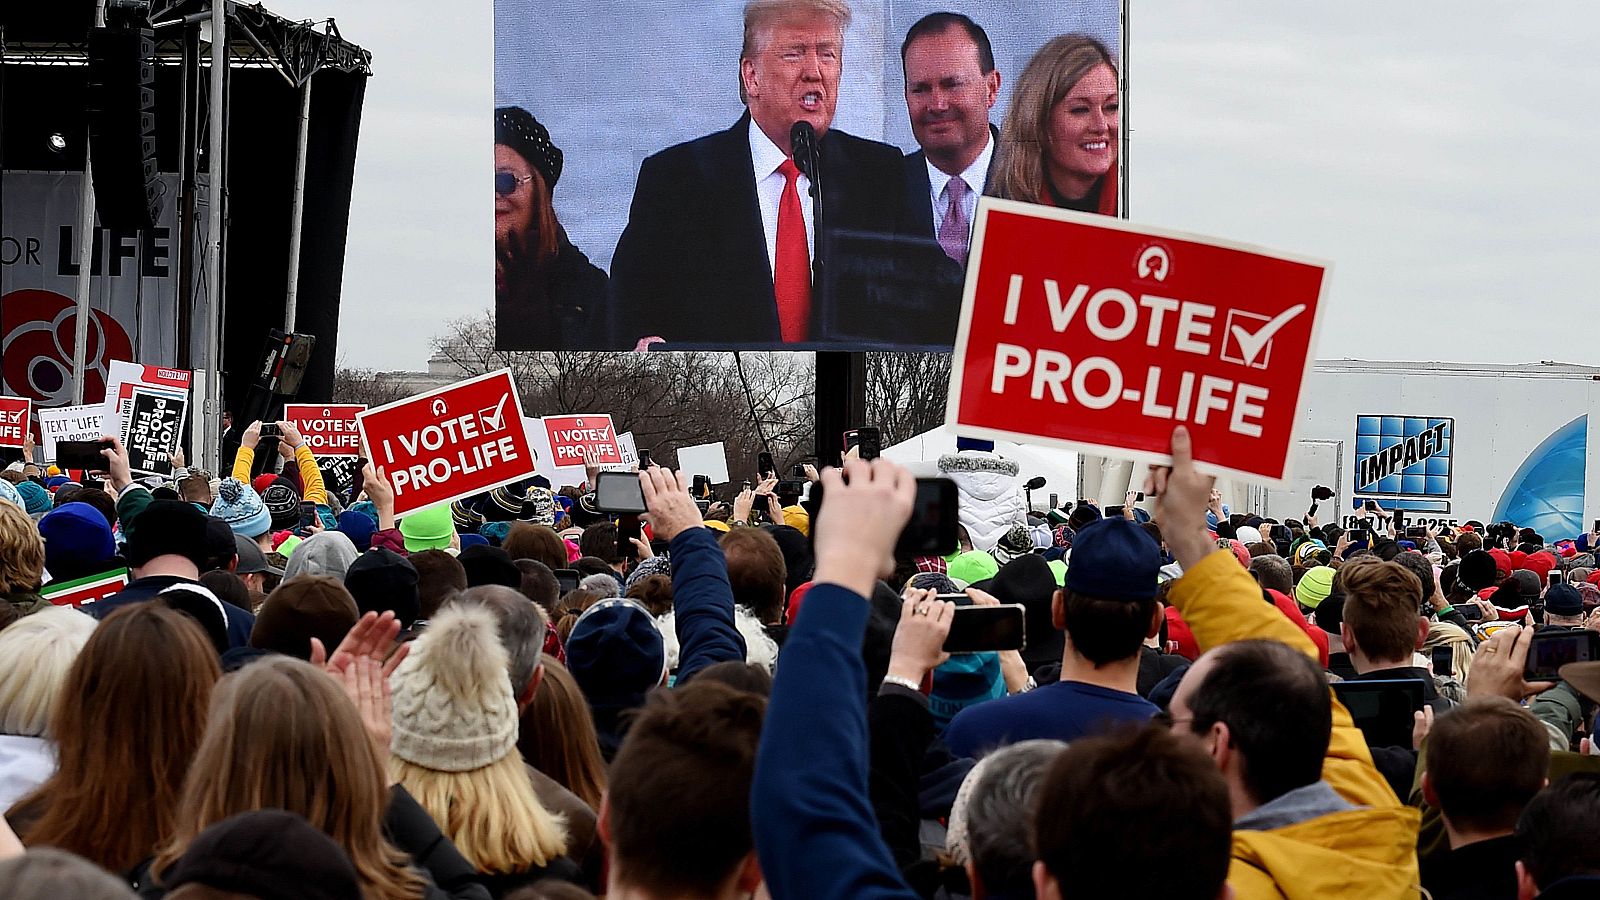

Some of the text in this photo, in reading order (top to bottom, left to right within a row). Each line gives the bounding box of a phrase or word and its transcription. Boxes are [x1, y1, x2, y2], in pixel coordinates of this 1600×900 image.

[2, 225, 170, 277] OR LIFE
[1003, 274, 1023, 325] I
[1043, 279, 1216, 355] VOTE
[991, 342, 1269, 438] PRO-LIFE
[44, 419, 68, 434] TEXT
[133, 411, 151, 453] FIRST
[142, 398, 167, 471] PRO-LIFE
[156, 420, 174, 462] VOTE
[302, 419, 343, 432] VOTE
[302, 434, 359, 448] RO-LIFE
[382, 413, 480, 464] I VOTE
[553, 428, 597, 443] I VOTE
[391, 436, 518, 496] PRO-LIFE
[556, 443, 616, 459] PROLIFE
[1360, 421, 1447, 489] IMPACT
